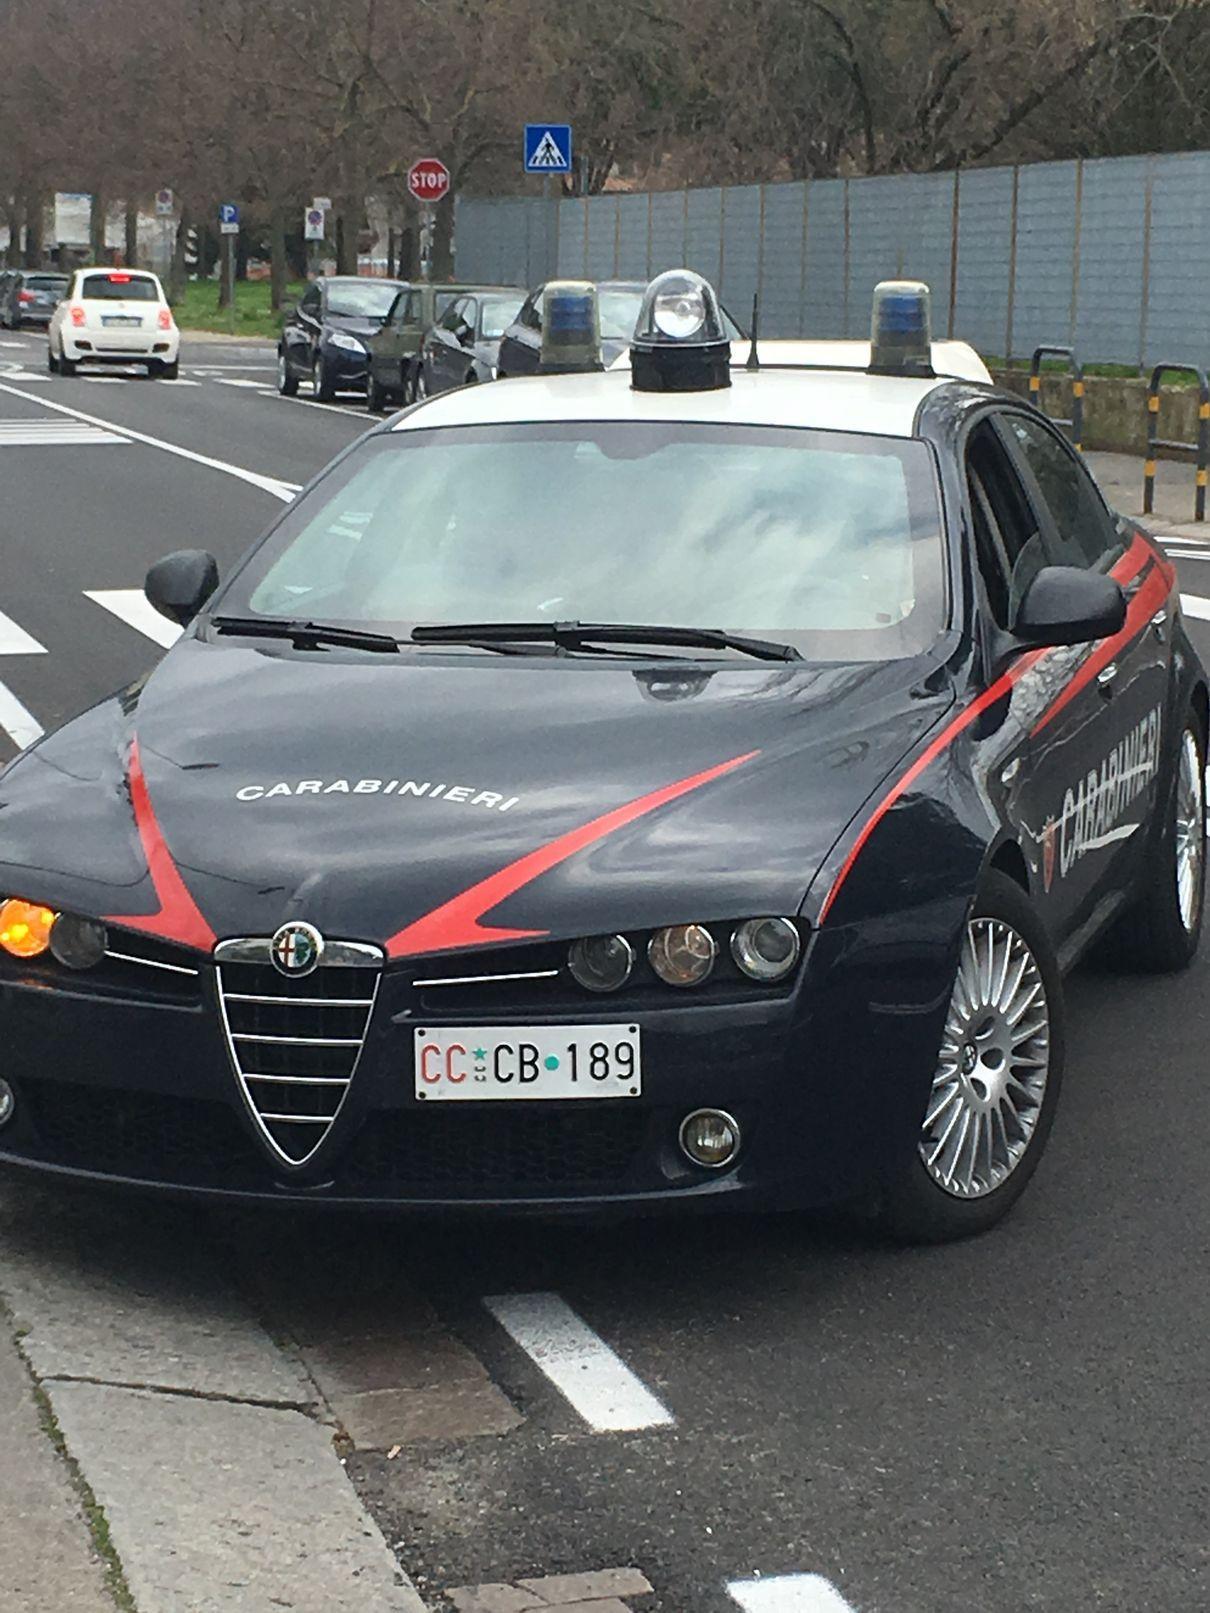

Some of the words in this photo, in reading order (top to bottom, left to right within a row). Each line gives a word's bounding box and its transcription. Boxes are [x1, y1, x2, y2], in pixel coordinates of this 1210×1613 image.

[411, 172, 447, 188] STOP
[223, 205, 235, 222] P
[235, 779, 520, 812] CARABINIERI
[421, 1044, 467, 1084] CC
[494, 1043, 540, 1083] CB
[566, 1041, 635, 1082] 189
